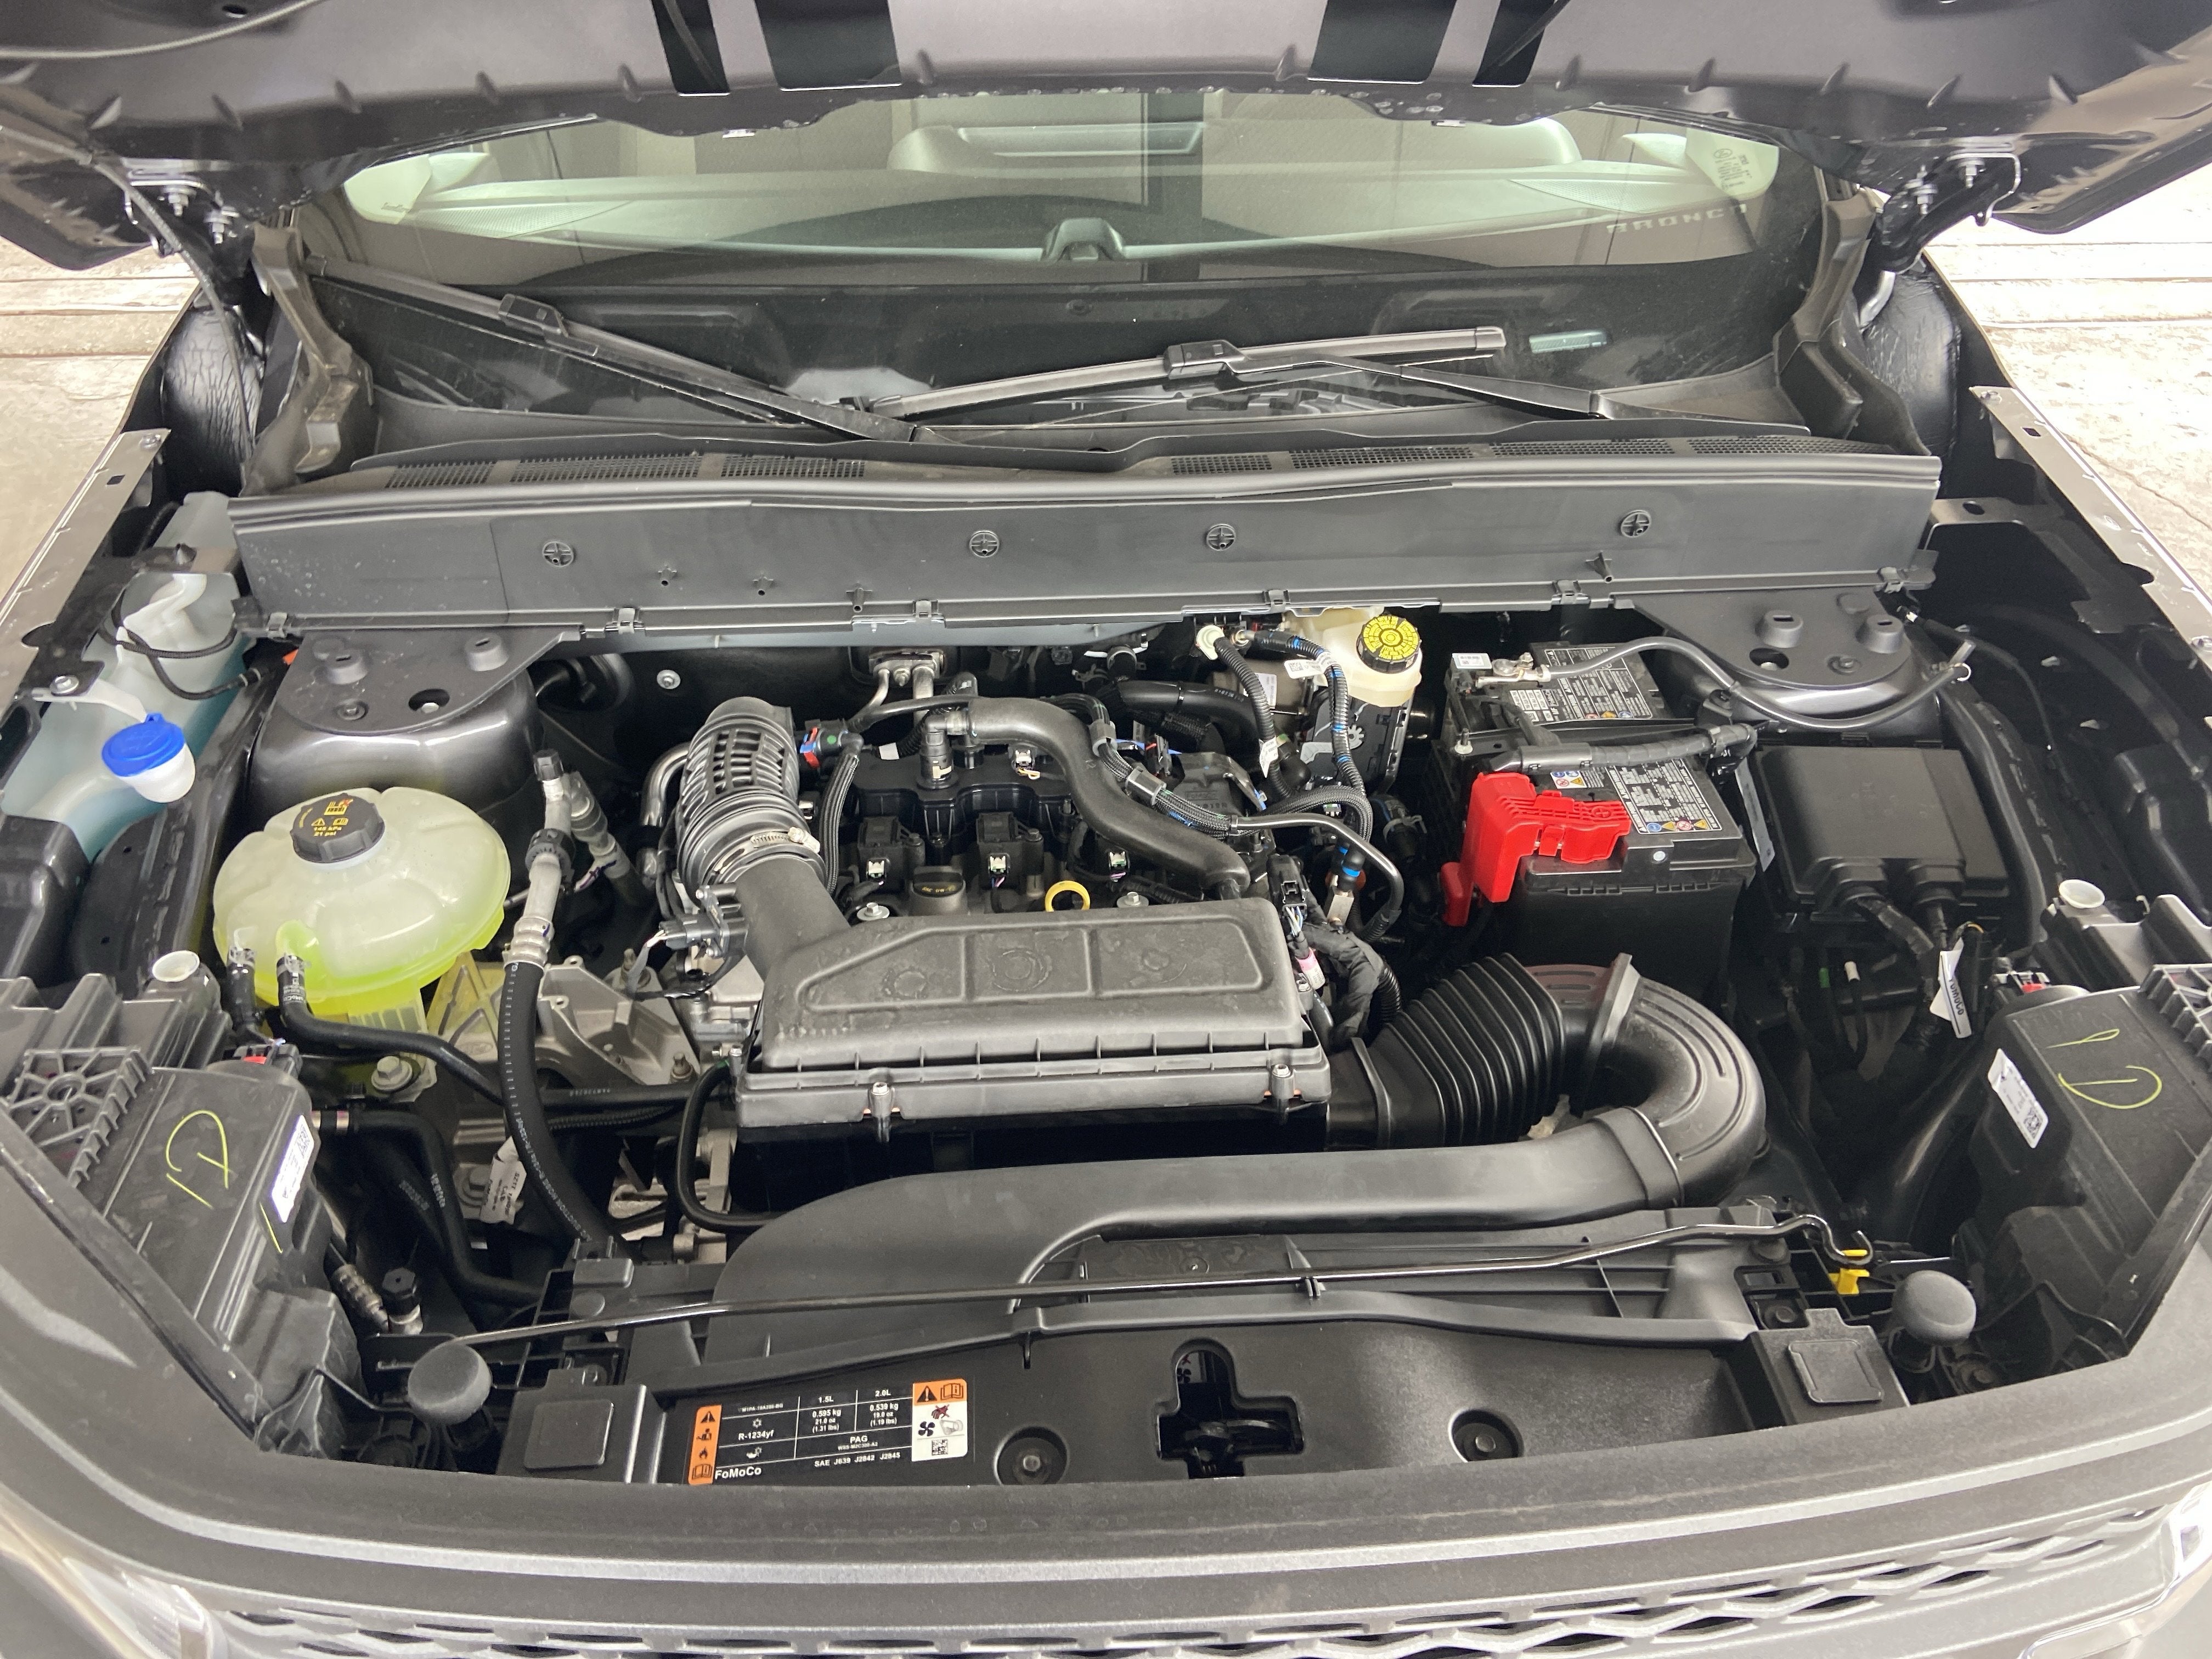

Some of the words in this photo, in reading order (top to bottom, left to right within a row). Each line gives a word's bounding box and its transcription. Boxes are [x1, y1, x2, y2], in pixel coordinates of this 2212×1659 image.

[875, 1389, 891, 1397] 2.0L
[870, 1403, 888, 1412] 0.539
[812, 1409, 831, 1418] 0.595
[832, 1409, 842, 1417] kg
[870, 1419, 885, 1427] (1.19
[885, 1417, 897, 1425] lbs)
[738, 1429, 775, 1441] R-1234yf
[850, 1435, 868, 1443] PAG
[814, 1459, 830, 1468] SAE
[833, 1457, 851, 1465] J639
[879, 1452, 900, 1460] J2845
[715, 1466, 762, 1480] FoMoCo
